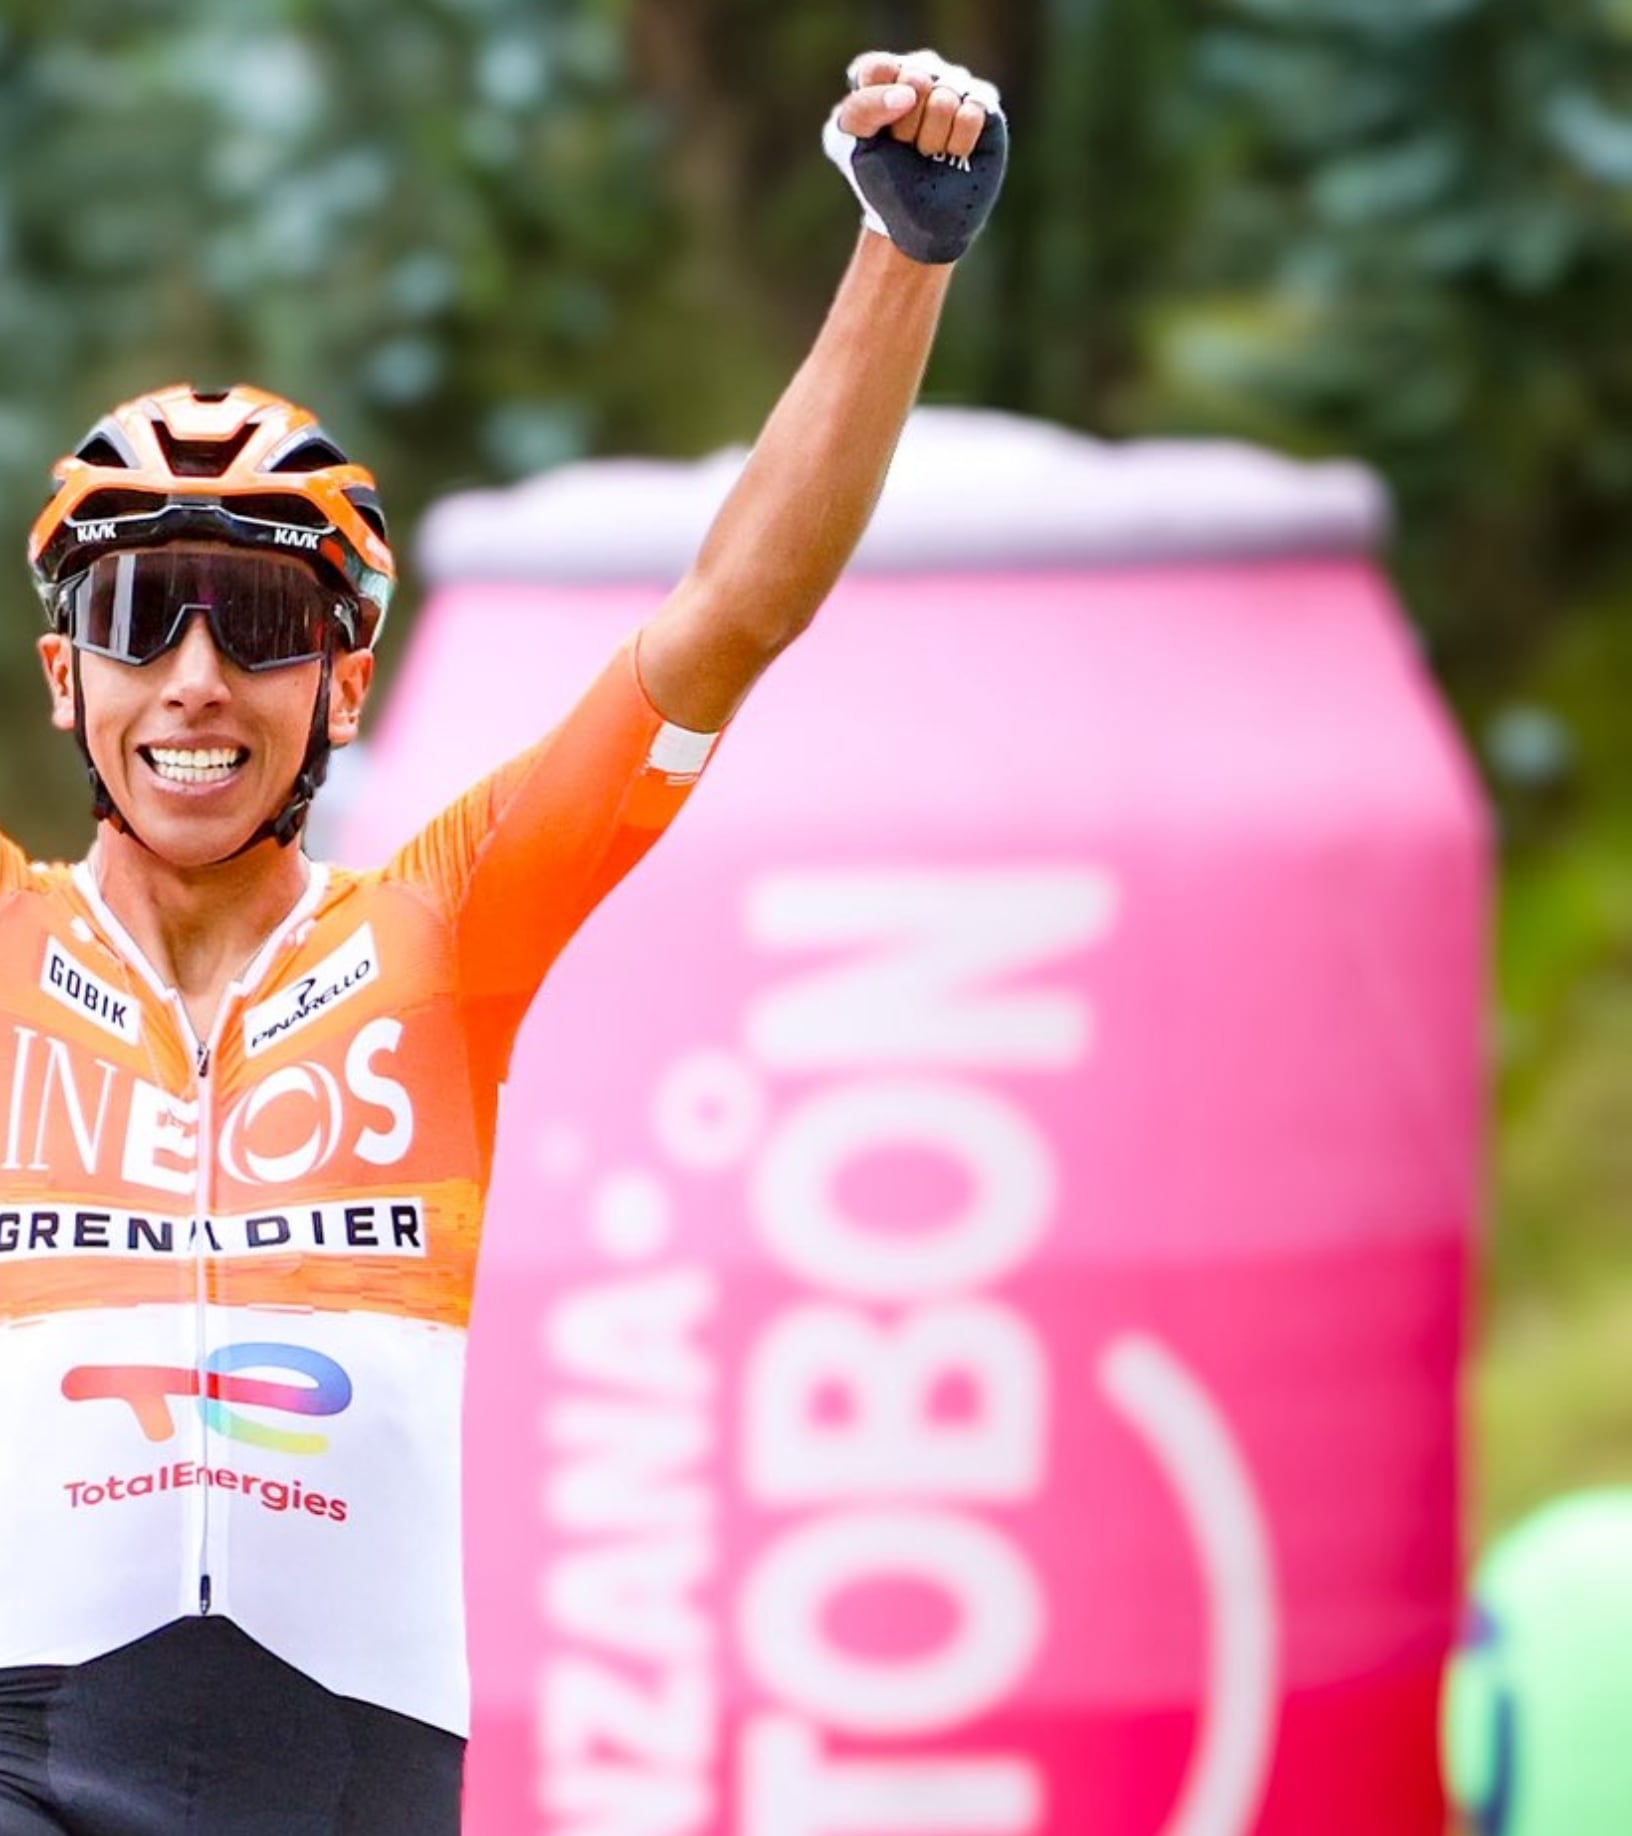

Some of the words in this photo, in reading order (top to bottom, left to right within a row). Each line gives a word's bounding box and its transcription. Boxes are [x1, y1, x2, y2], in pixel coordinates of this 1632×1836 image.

[77, 523, 117, 543] KASK
[274, 528, 320, 549] KASK
[49, 953, 127, 1029] GOBIK
[251, 959, 371, 1048] PINARELLO
[0, 1017, 415, 1195] INEOS
[64, 1462, 348, 1522] TotalEnergies
